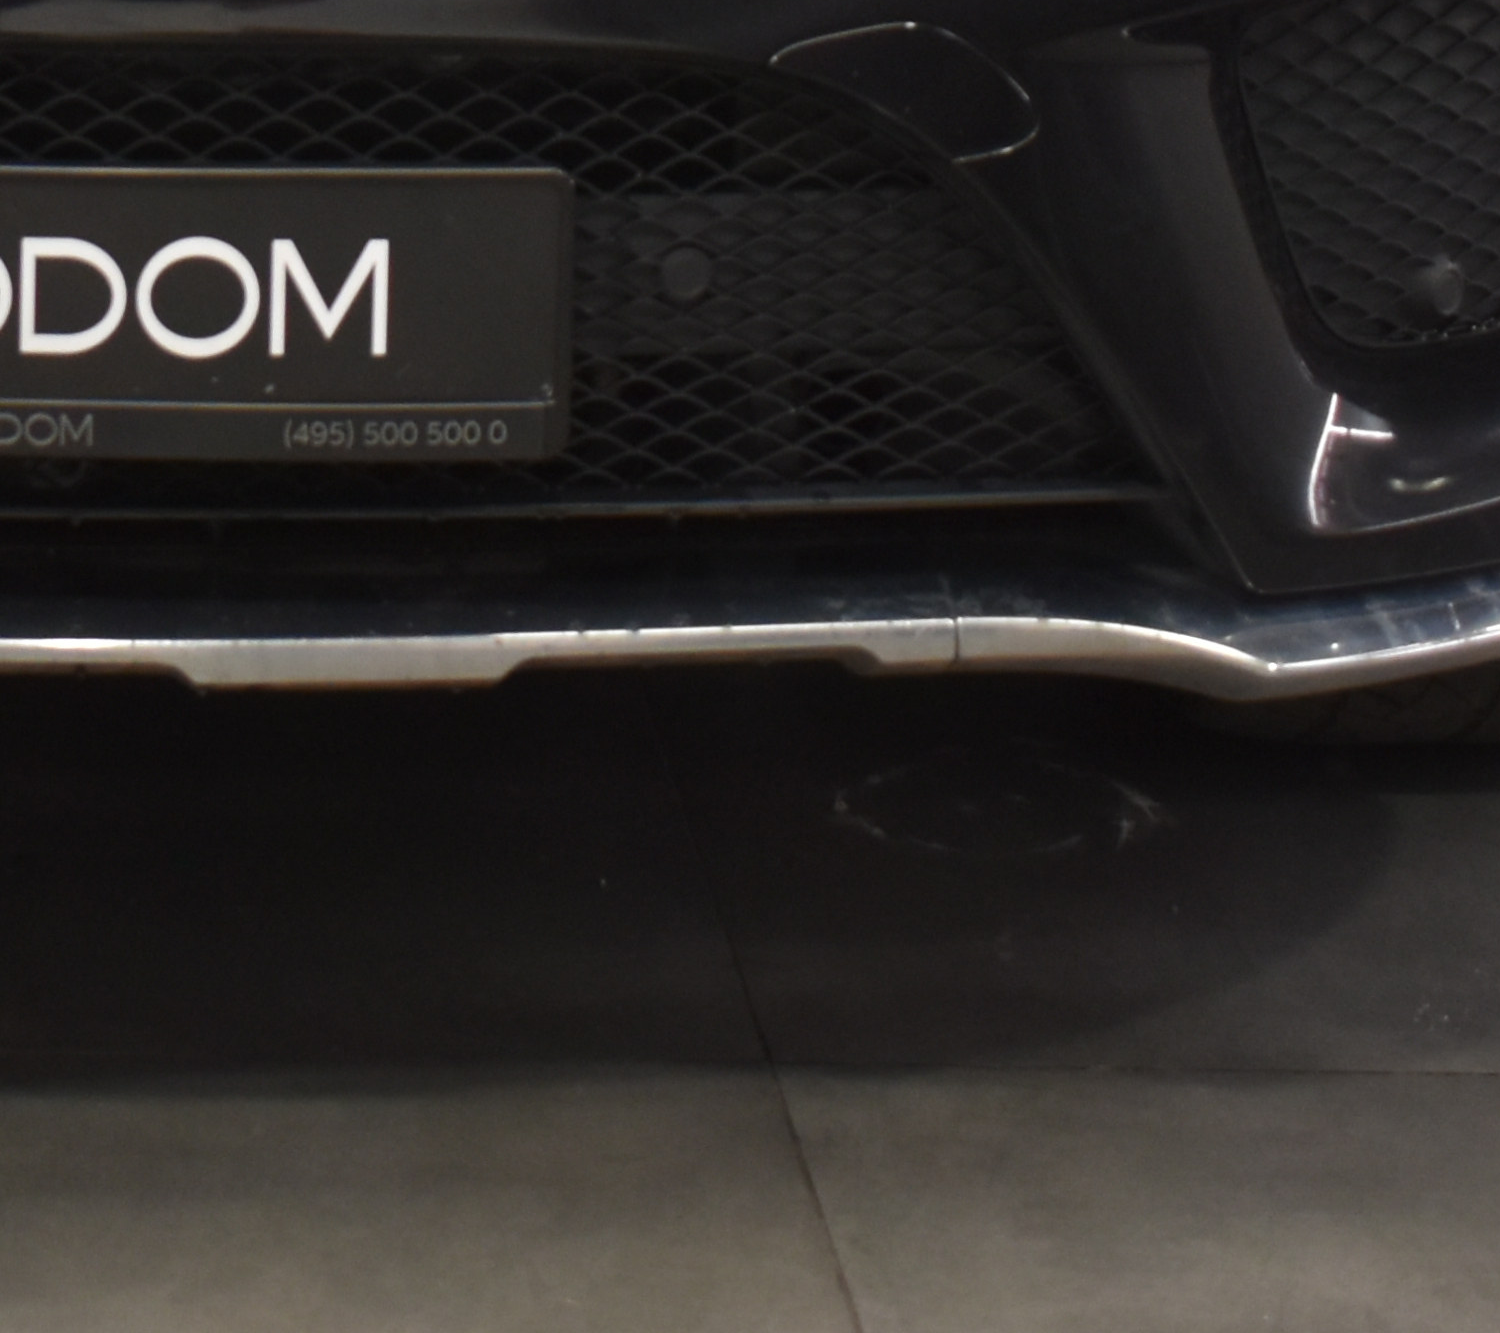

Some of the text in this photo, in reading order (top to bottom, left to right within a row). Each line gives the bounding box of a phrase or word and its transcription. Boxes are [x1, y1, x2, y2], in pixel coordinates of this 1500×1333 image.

[283, 418, 508, 450] (495) 500 500 0
